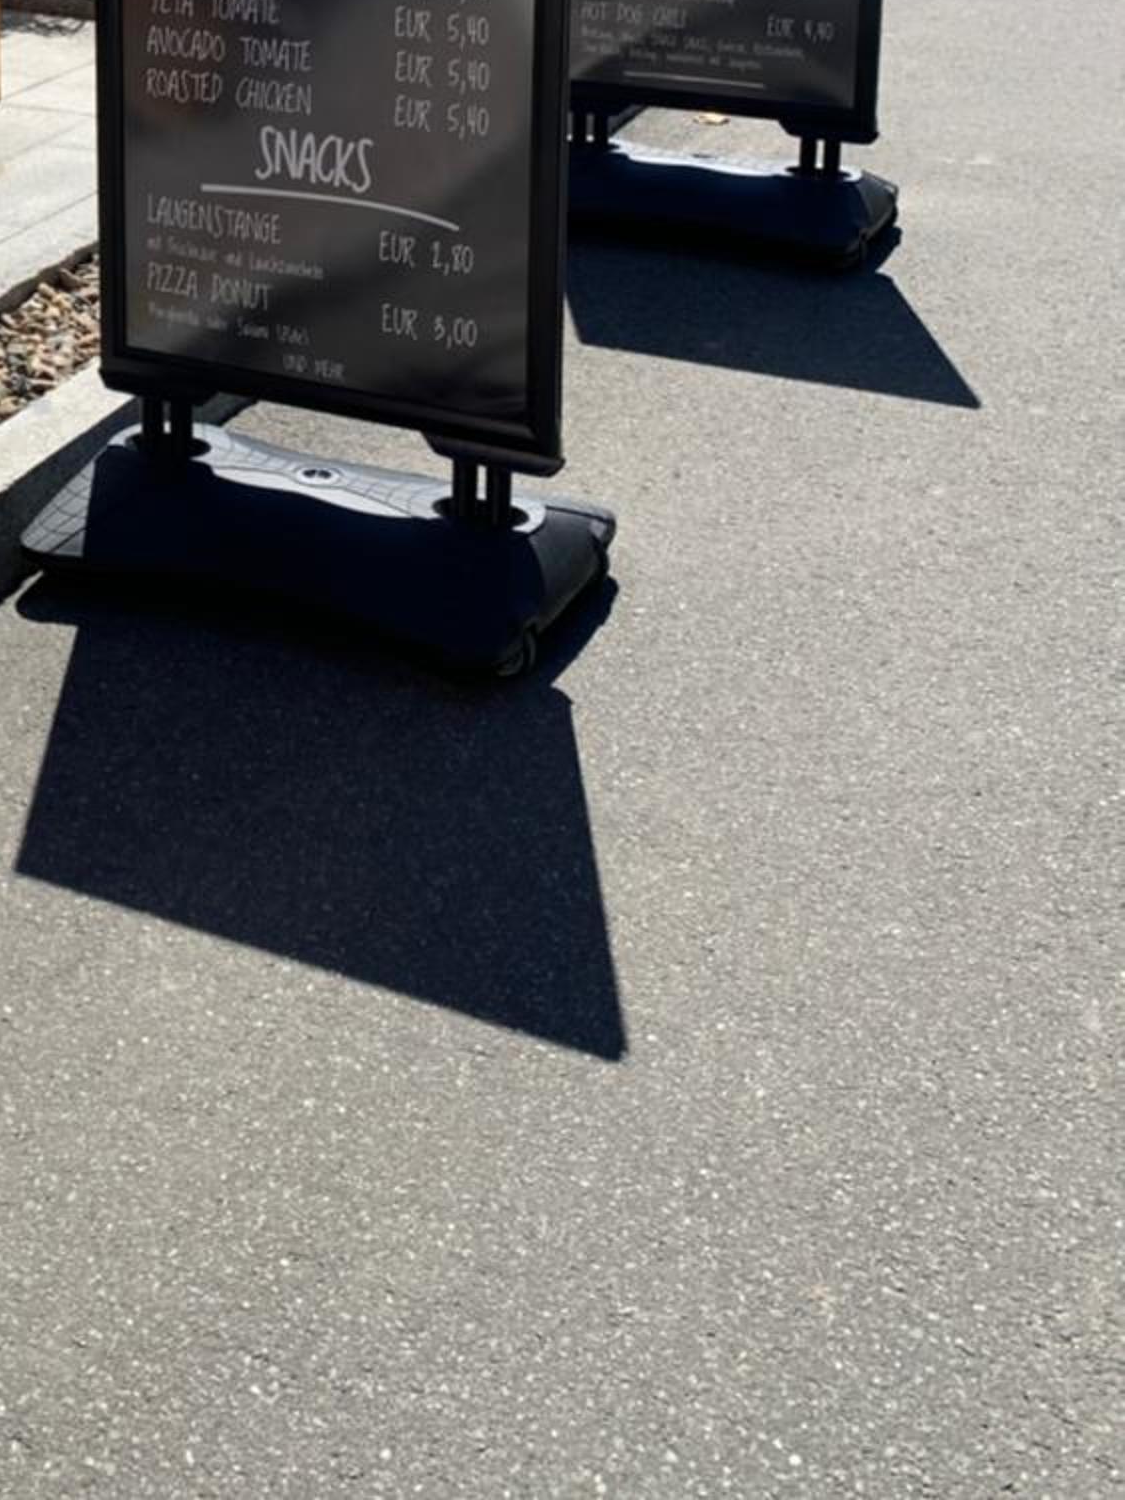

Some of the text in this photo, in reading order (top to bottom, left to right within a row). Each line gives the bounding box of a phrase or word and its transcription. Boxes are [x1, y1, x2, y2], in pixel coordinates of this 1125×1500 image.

[146, 24, 491, 96] AVOCADO TOMATE EUR 5,40
[394, 5, 431, 43] EUR
[446, 12, 490, 52] 5,40
[766, 13, 795, 38] EUR
[145, 67, 490, 140] ROASTED CHICKEN EUR 5,40
[255, 125, 374, 194] SNACKS
[146, 194, 475, 277] LAUGENSTANGE EUR 1,80
[146, 261, 479, 349] PIZZA DONUT EUR 3,00
